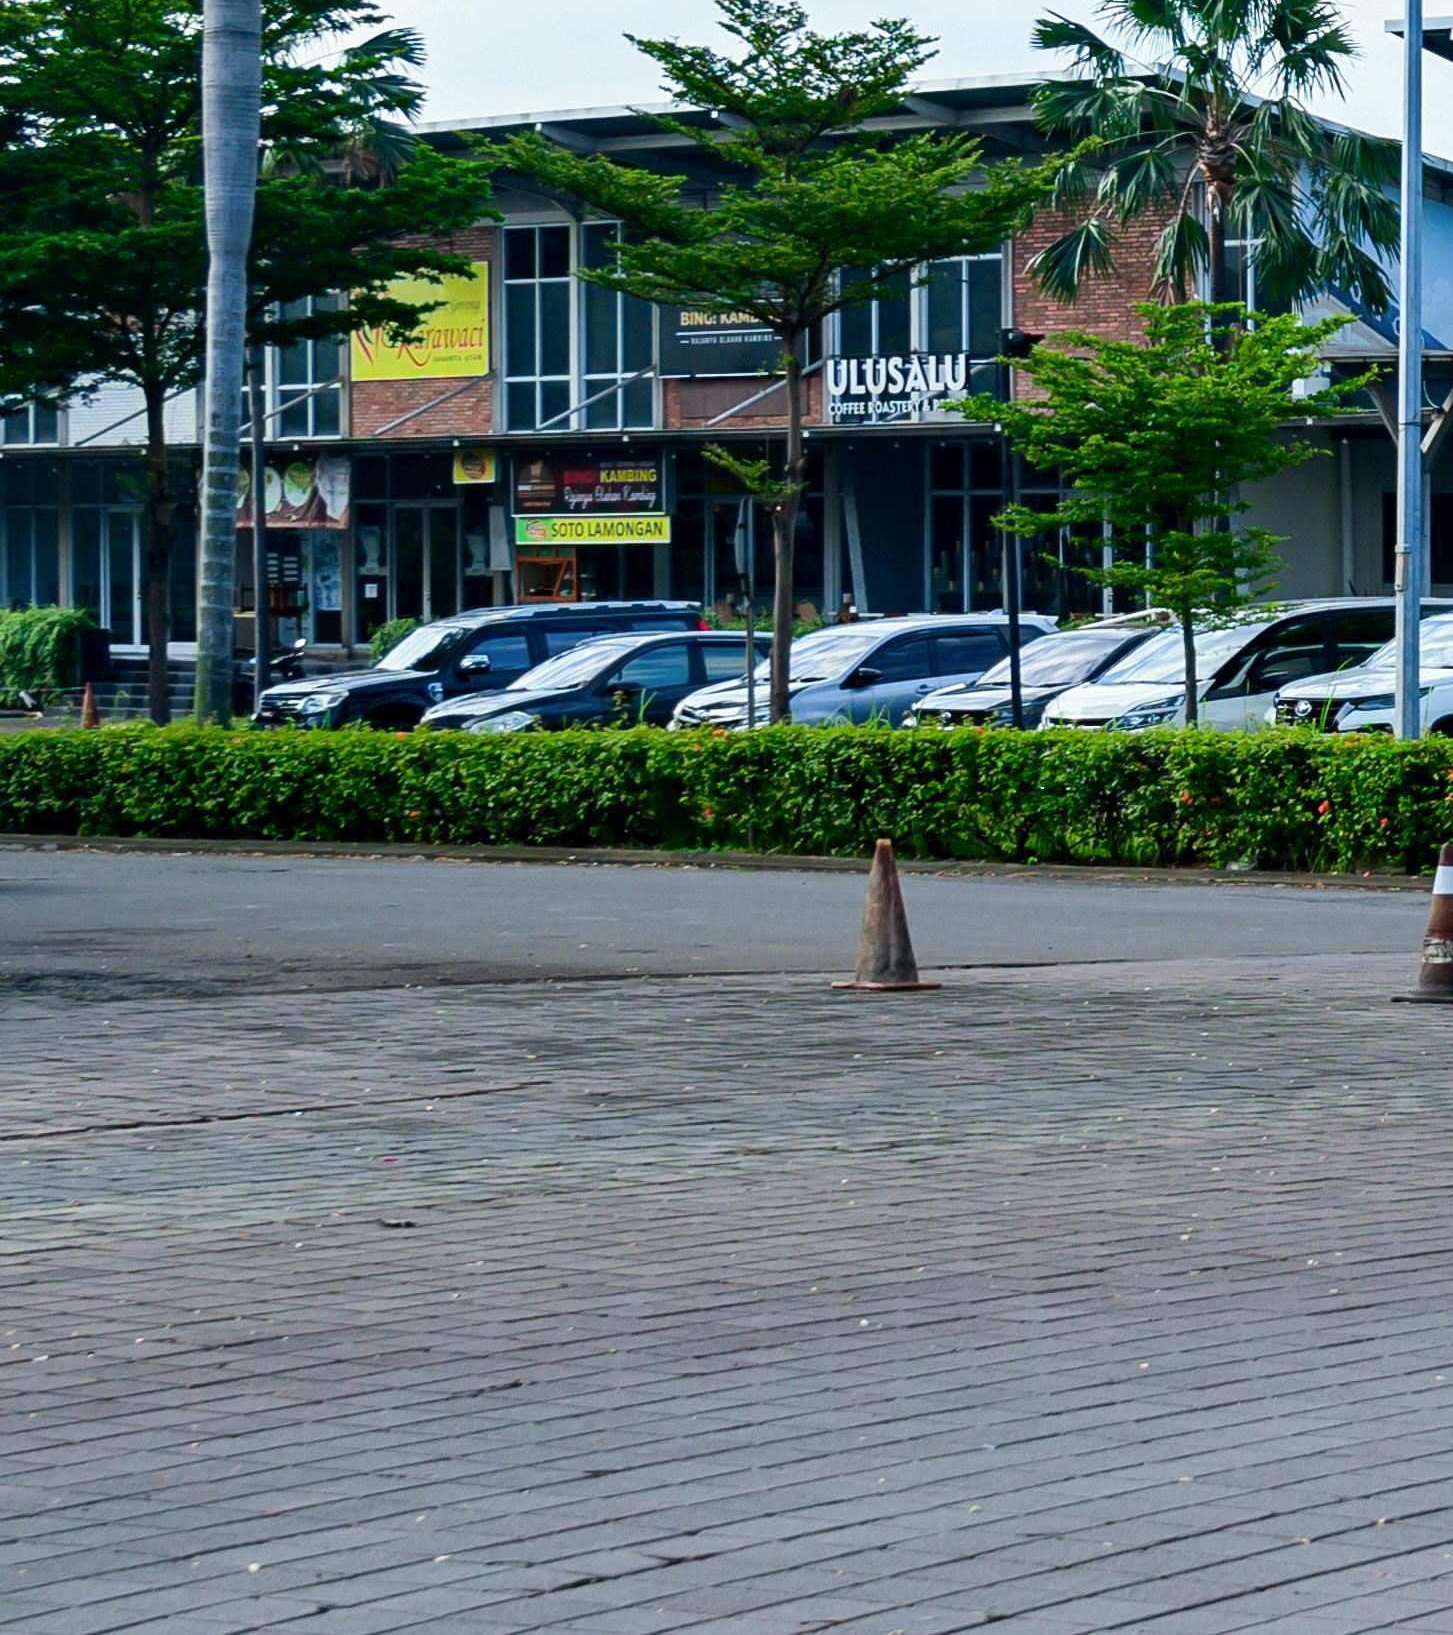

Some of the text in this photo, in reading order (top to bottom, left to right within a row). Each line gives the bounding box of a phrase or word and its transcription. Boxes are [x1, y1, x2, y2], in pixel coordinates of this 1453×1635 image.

[827, 353, 966, 396] ULUSALU
[827, 401, 865, 416] COFFEE
[868, 398, 919, 414] ROASTERY
[600, 468, 657, 484] KAMBING
[551, 520, 663, 538] SOTO LAMONGAN
